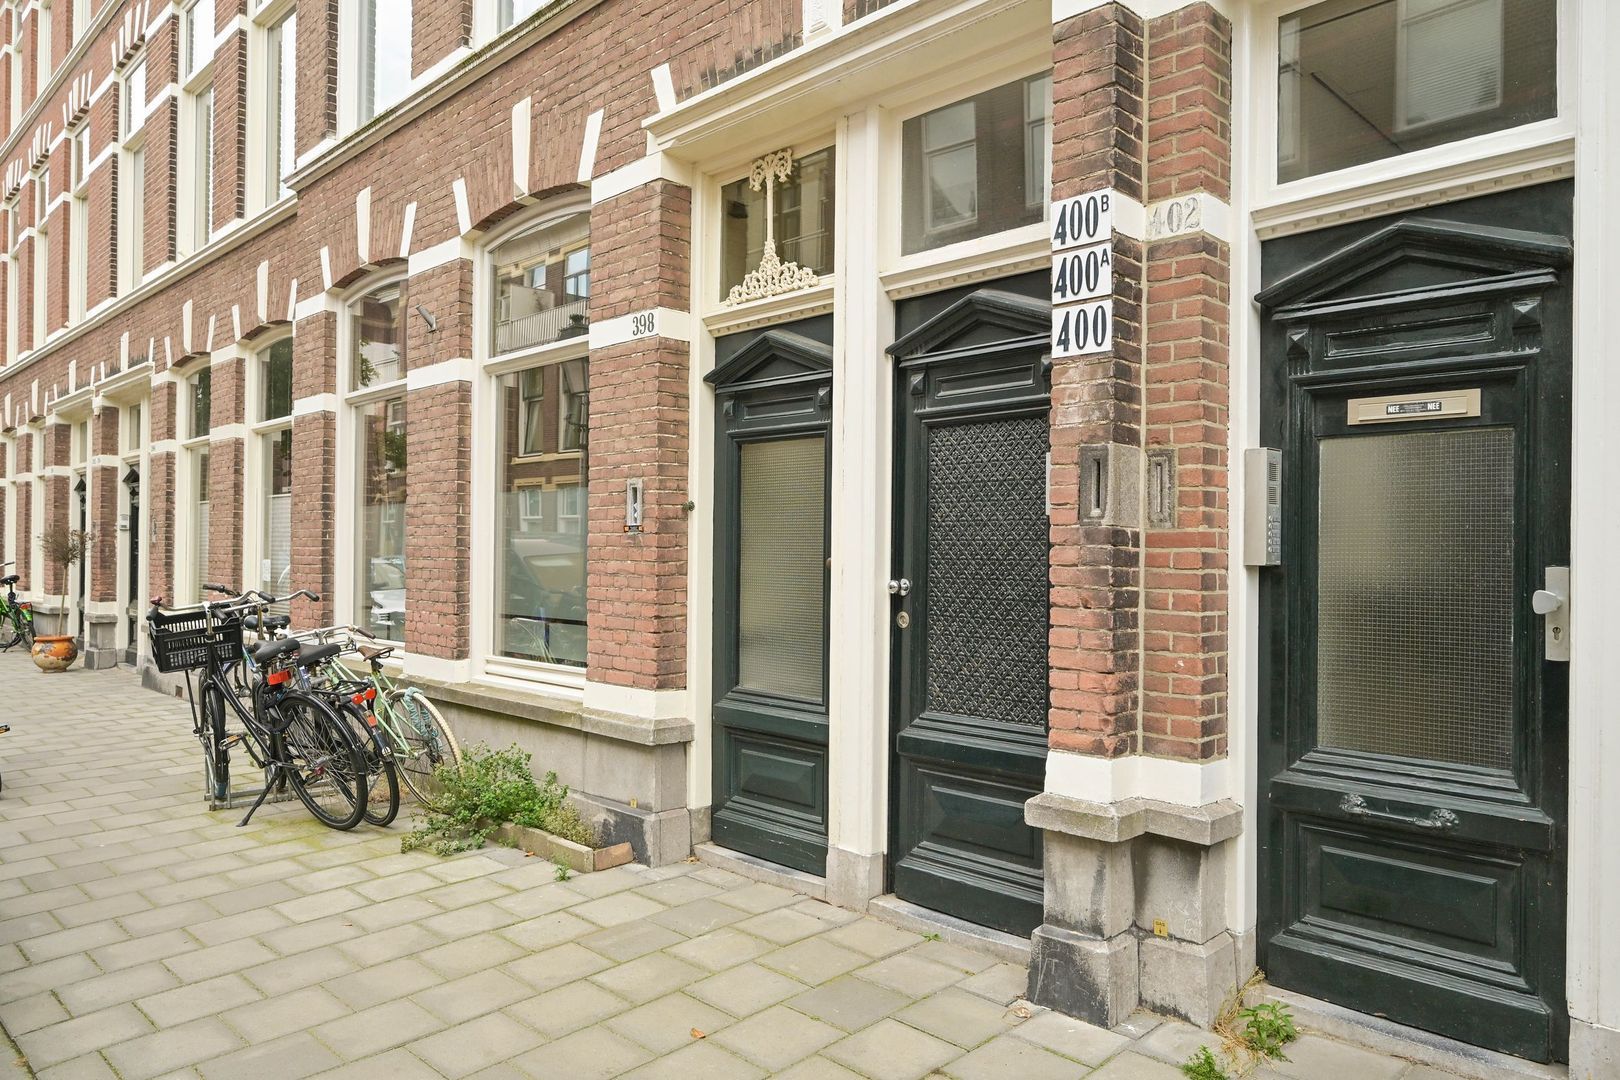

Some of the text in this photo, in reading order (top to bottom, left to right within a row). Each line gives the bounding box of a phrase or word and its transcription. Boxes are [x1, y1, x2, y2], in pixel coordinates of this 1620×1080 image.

[632, 312, 655, 336] 398
[1056, 305, 1107, 352] 400
[1387, 405, 1400, 414] NEE
[1427, 402, 1440, 411] NEE
